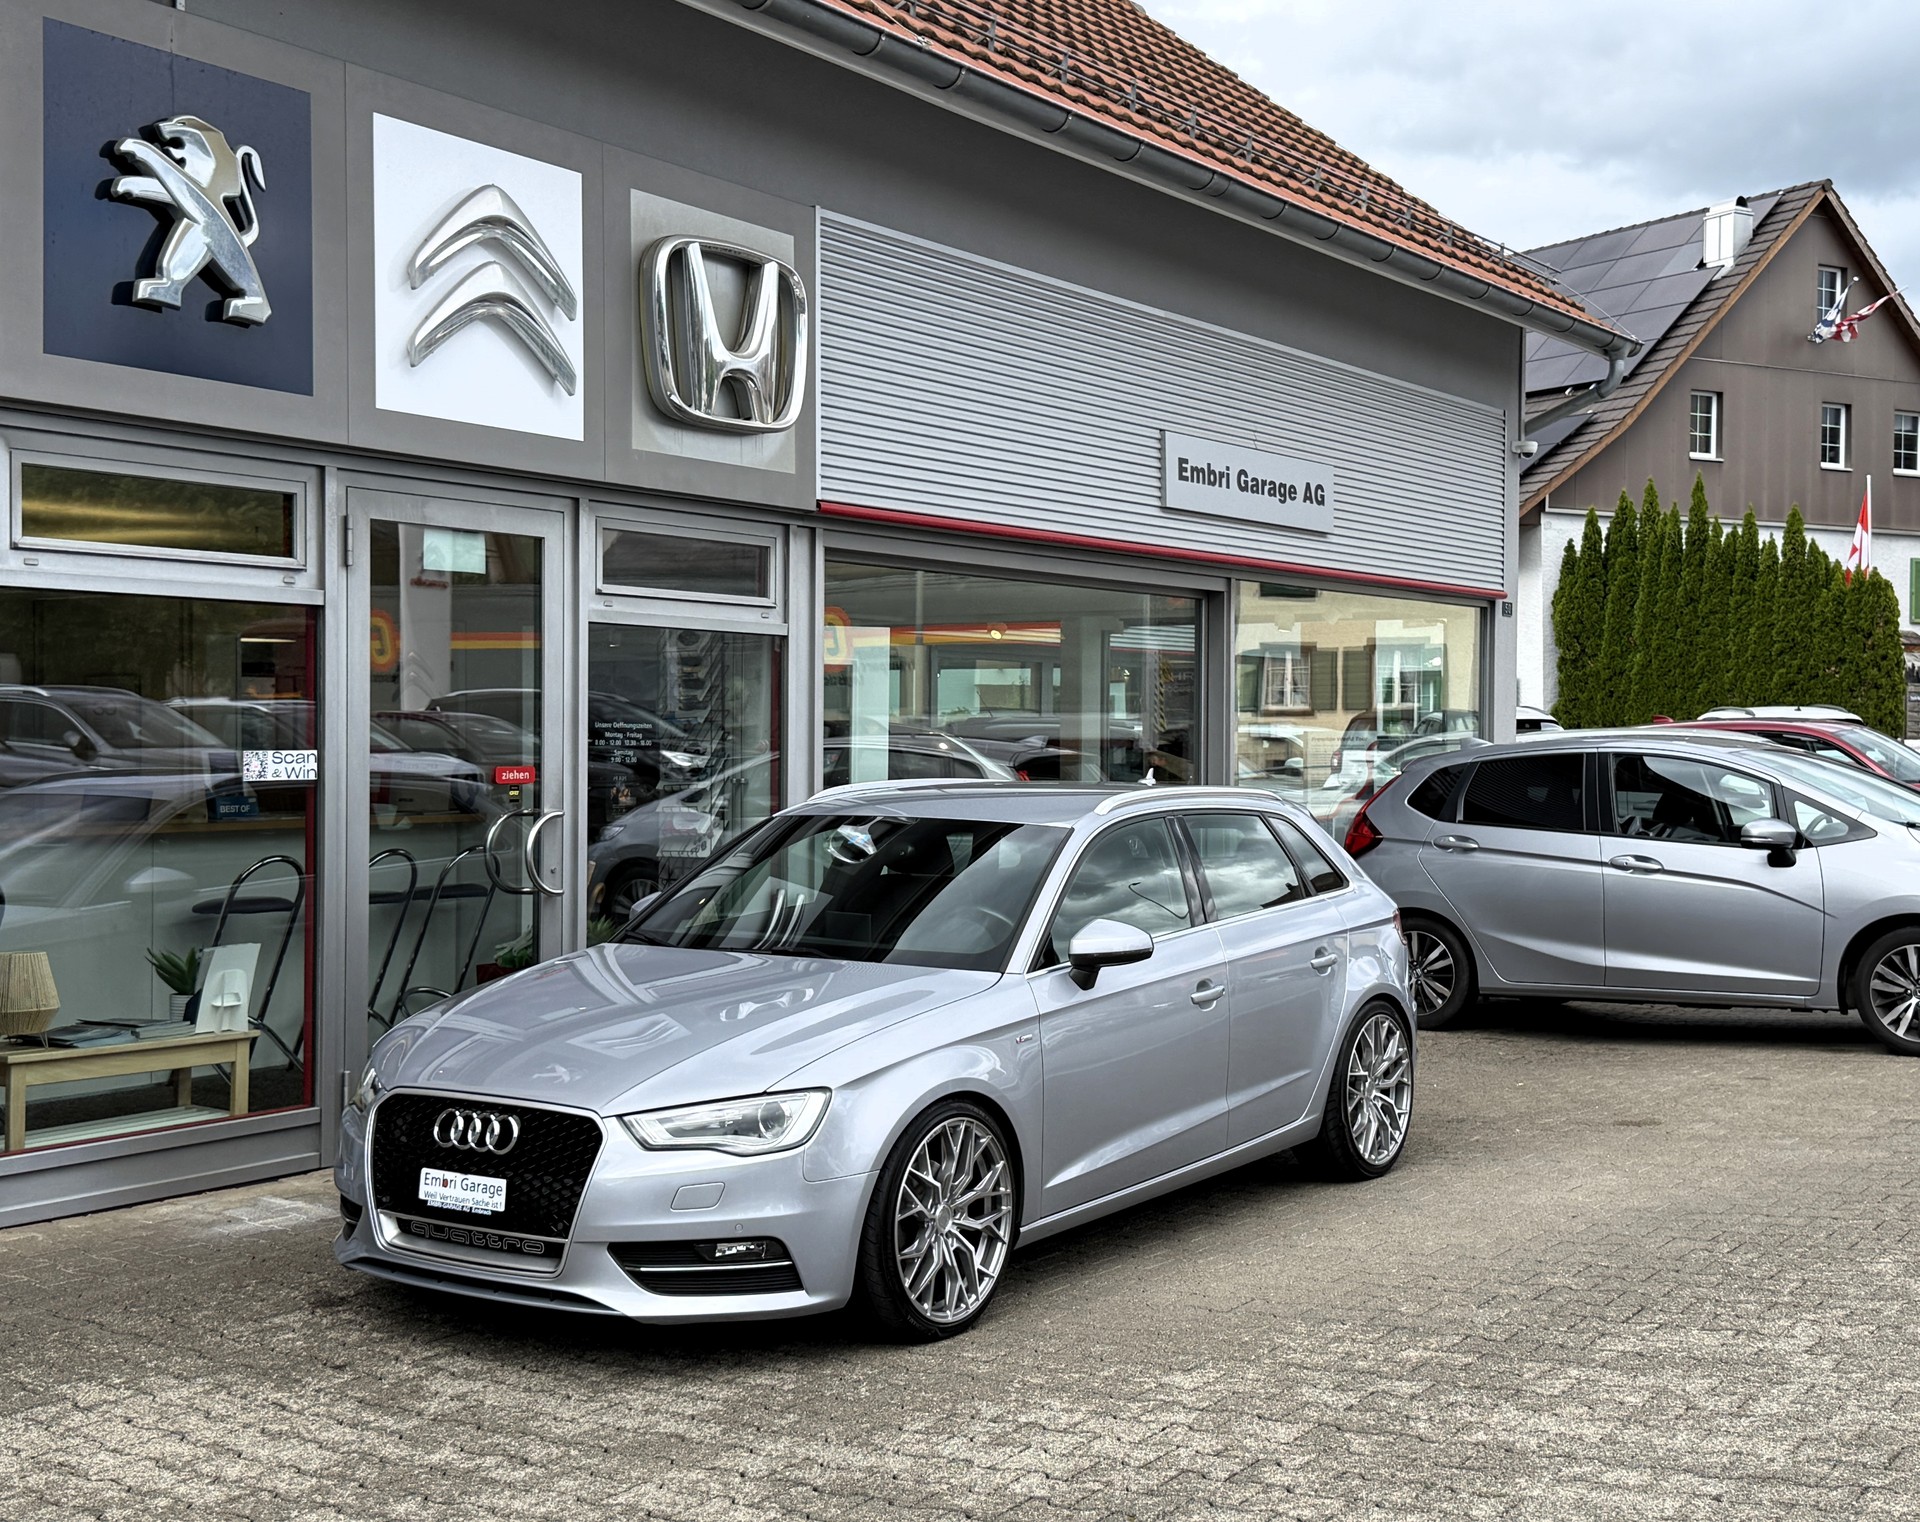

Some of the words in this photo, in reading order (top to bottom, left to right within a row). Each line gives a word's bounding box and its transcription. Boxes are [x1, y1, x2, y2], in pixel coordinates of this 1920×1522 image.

[683, 242, 781, 425] H
[1177, 457, 1231, 490] Embri
[1236, 468, 1298, 505] Garage
[1302, 481, 1326, 507] AG
[271, 751, 318, 765] Scan
[271, 768, 282, 778] &
[284, 764, 318, 779] Win
[501, 769, 530, 780] ziehen
[219, 804, 240, 813] BEST
[240, 804, 251, 813] OF
[423, 1172, 458, 1190] Embri
[460, 1177, 503, 1199] Garage
[423, 1190, 438, 1199] Weil
[439, 1193, 470, 1205] Vertrauen
[471, 1197, 491, 1208] Sache
[411, 1220, 544, 1254] quattro
